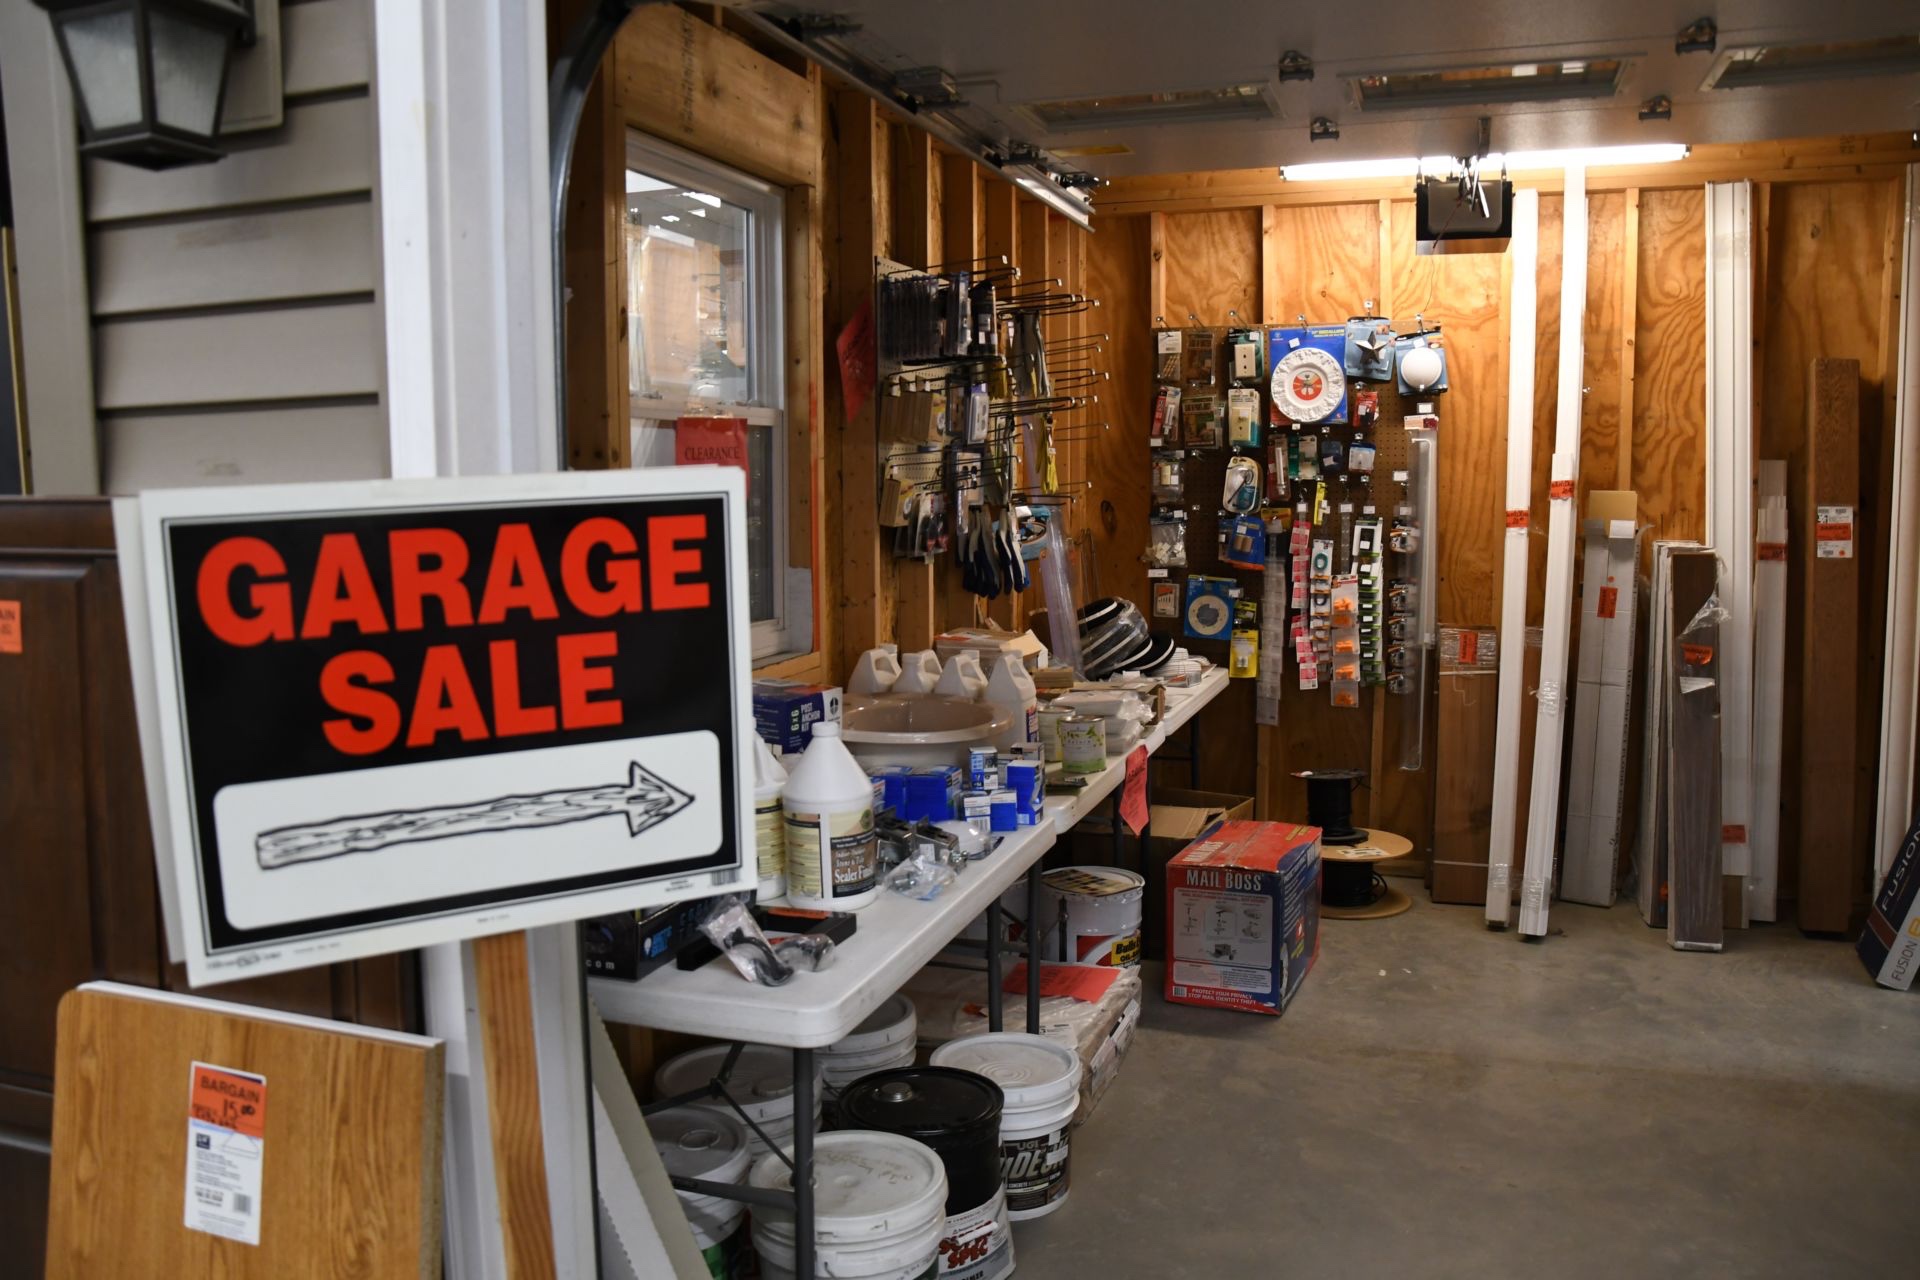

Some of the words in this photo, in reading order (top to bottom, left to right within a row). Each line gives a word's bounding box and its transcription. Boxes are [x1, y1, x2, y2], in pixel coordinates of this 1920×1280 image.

[684, 447, 741, 461] CLEARANCE
[196, 514, 711, 648] GARAGE
[319, 631, 624, 755] SALE
[834, 868, 858, 883] Sealer
[1186, 869, 1221, 888] MAIL
[1225, 872, 1262, 892] BOSS
[1891, 940, 1918, 982] FUSION
[201, 1075, 260, 1103] BARGAIN
